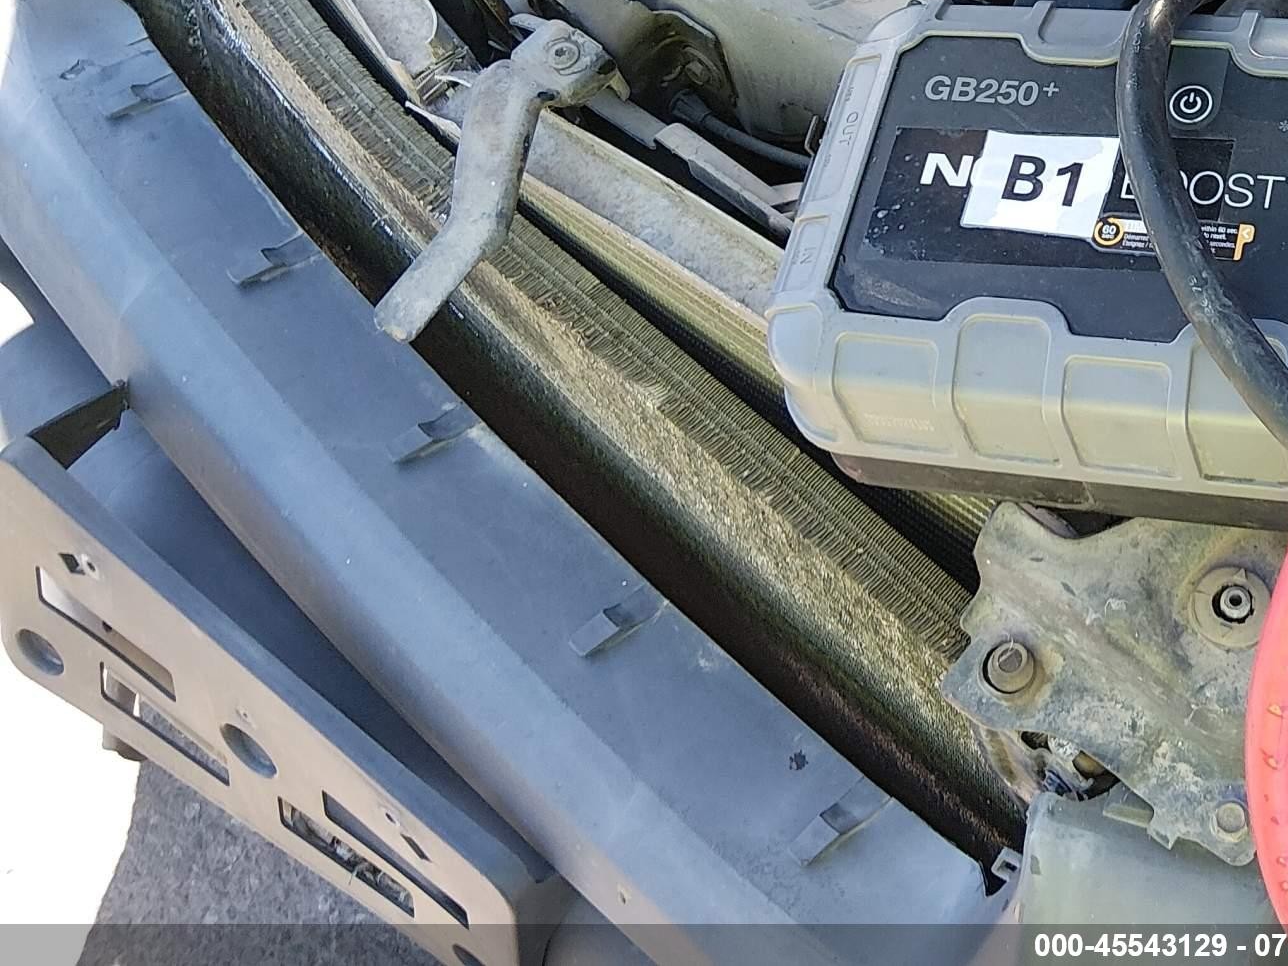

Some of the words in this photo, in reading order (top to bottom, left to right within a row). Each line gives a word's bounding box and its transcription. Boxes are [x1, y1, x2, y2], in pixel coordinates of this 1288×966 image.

[924, 75, 1060, 106] GB250+
[839, 111, 859, 146] OUT
[1001, 154, 1085, 207] B1
[1102, 224, 1117, 234] 60
